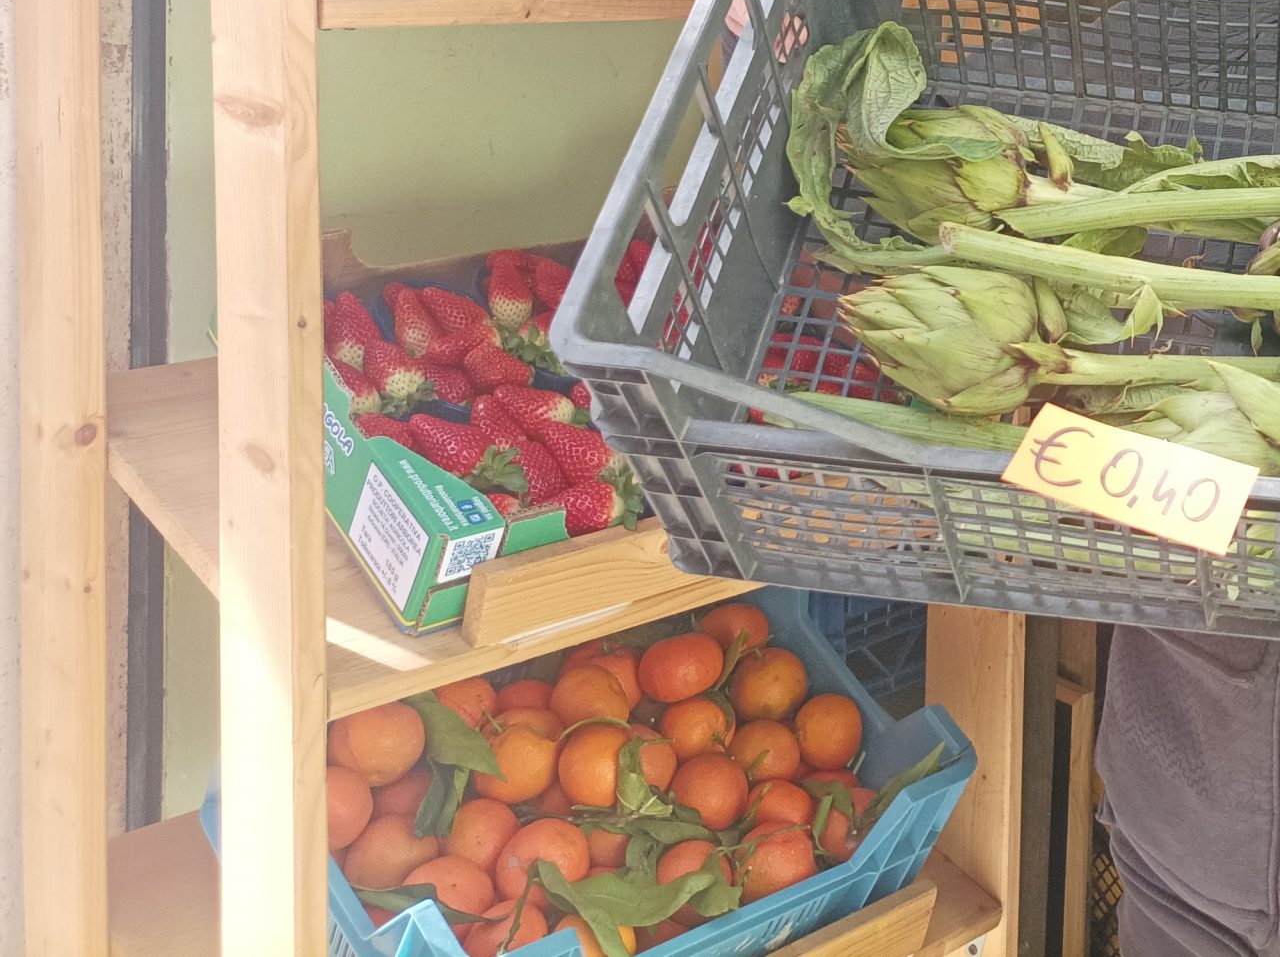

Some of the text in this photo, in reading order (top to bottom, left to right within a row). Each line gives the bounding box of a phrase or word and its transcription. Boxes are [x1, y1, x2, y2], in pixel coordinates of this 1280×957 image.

[324, 403, 354, 457] GOLA
[1030, 426, 1221, 523] € 0,40
[365, 477, 422, 557] PRODUTTORI ARBOREA
[384, 489, 422, 543] COOPERATIVA
